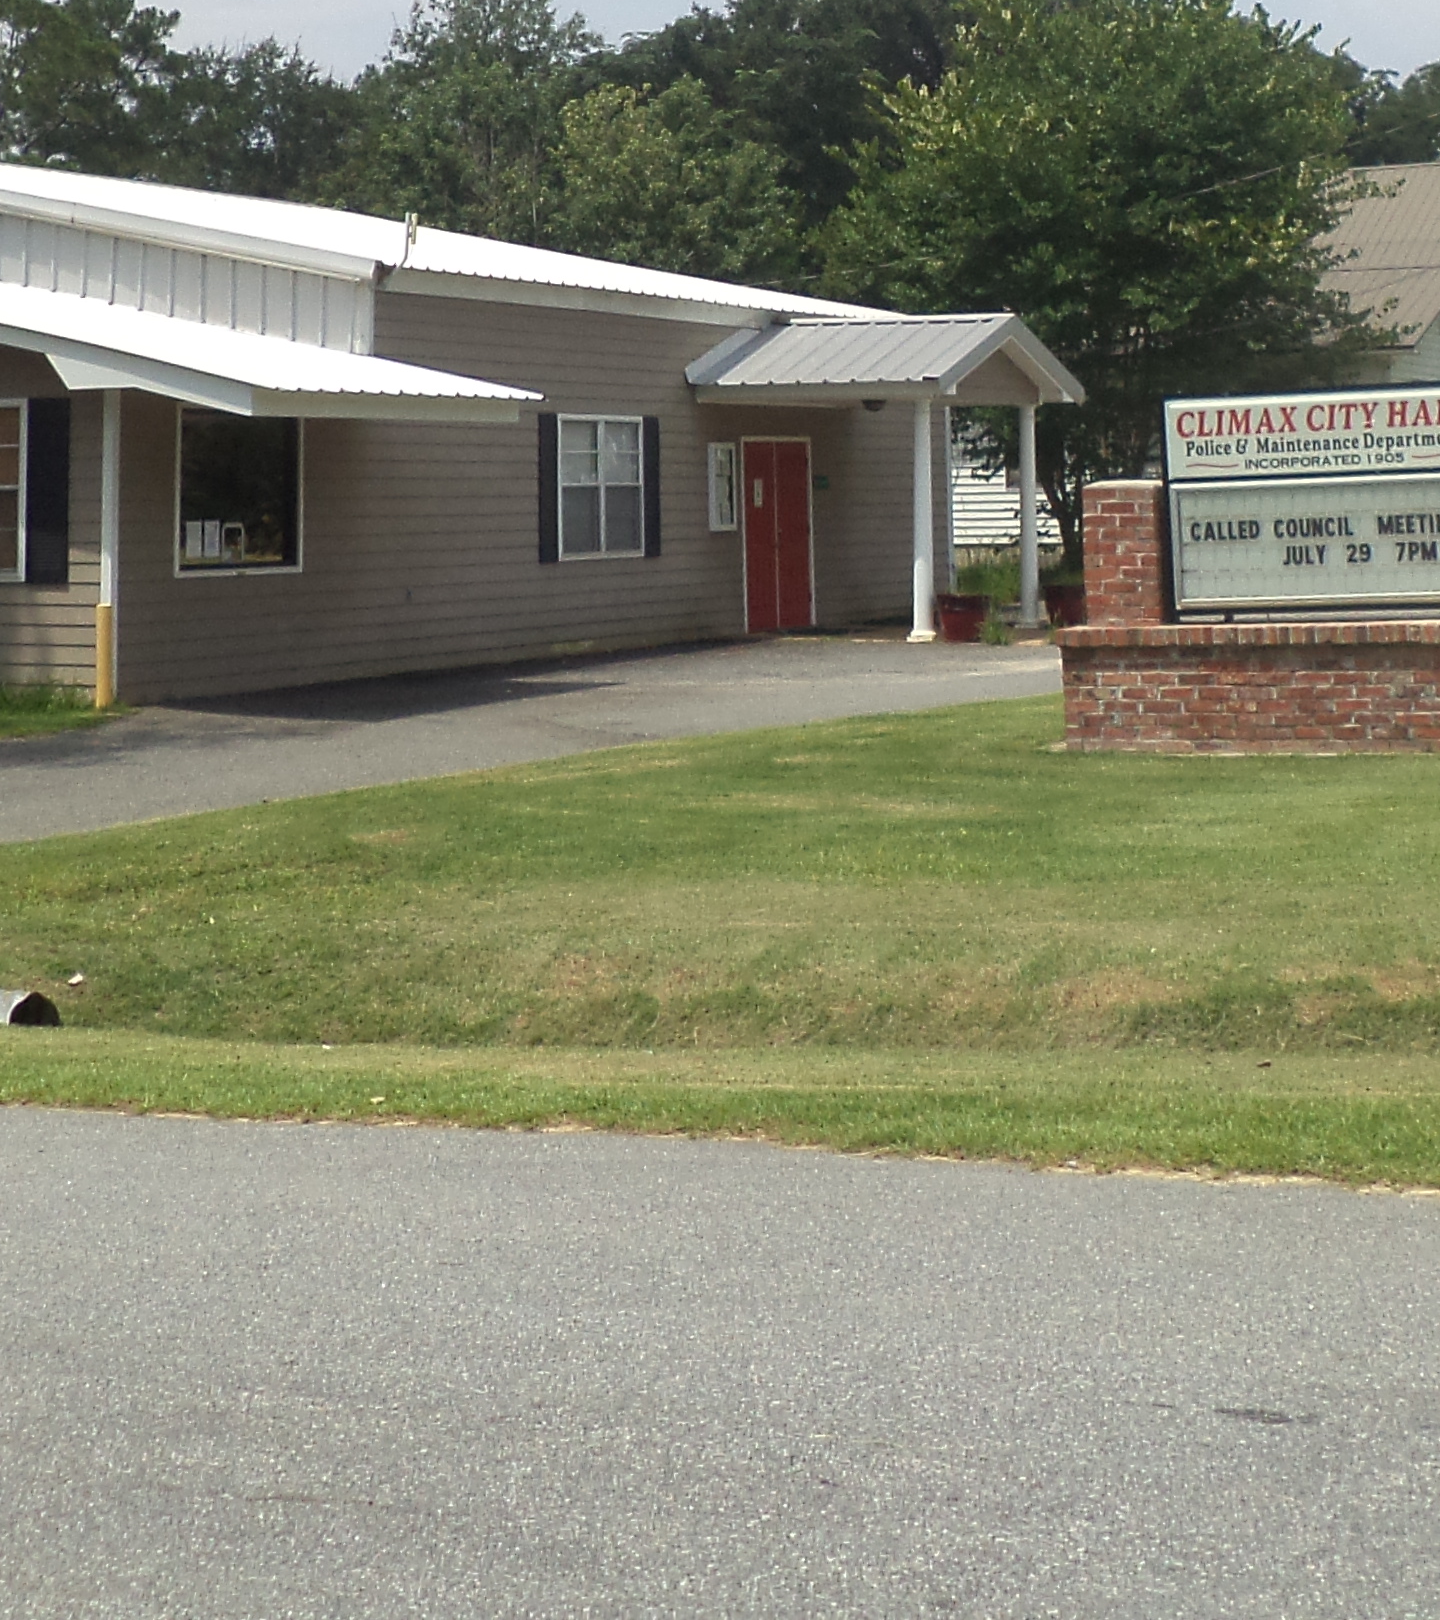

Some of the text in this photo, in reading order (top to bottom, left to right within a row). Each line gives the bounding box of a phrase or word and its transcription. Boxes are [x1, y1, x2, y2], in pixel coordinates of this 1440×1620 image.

[1176, 406, 1298, 438] CLIMAX
[1306, 402, 1379, 432] CITY
[1186, 438, 1232, 457] Police
[1236, 438, 1249, 455] &
[1256, 436, 1359, 454] Maintenance
[1245, 452, 1405, 470] INCORPORATED 1905
[1190, 520, 1260, 541] CALLED
[1273, 516, 1354, 539] COUNCIL
[1283, 541, 1438, 565] JULY 29 7PM
